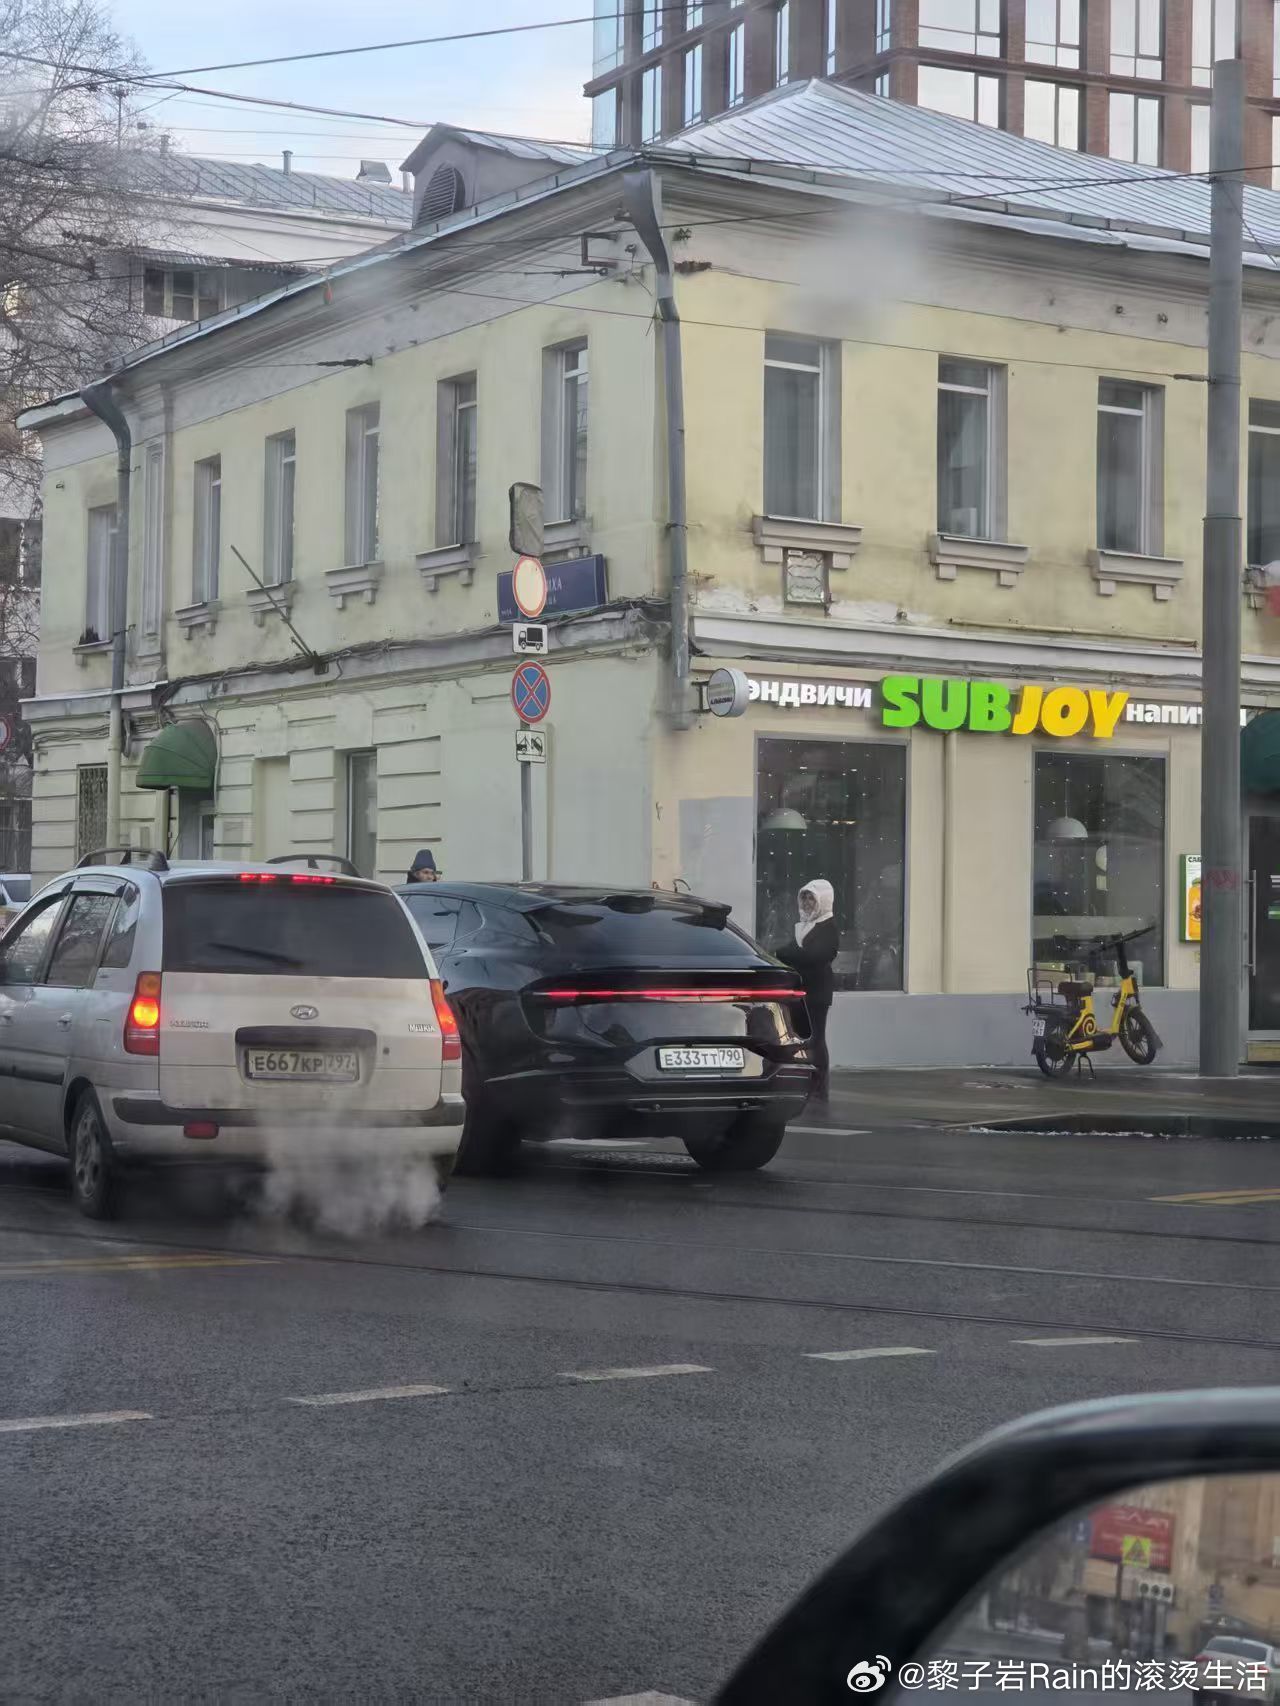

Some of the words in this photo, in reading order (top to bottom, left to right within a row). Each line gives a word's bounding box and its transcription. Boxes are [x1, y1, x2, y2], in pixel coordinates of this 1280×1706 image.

[747, 679, 872, 708] эндвичи
[1126, 703, 1247, 727] напи
[719, 1049, 741, 1061] 790
